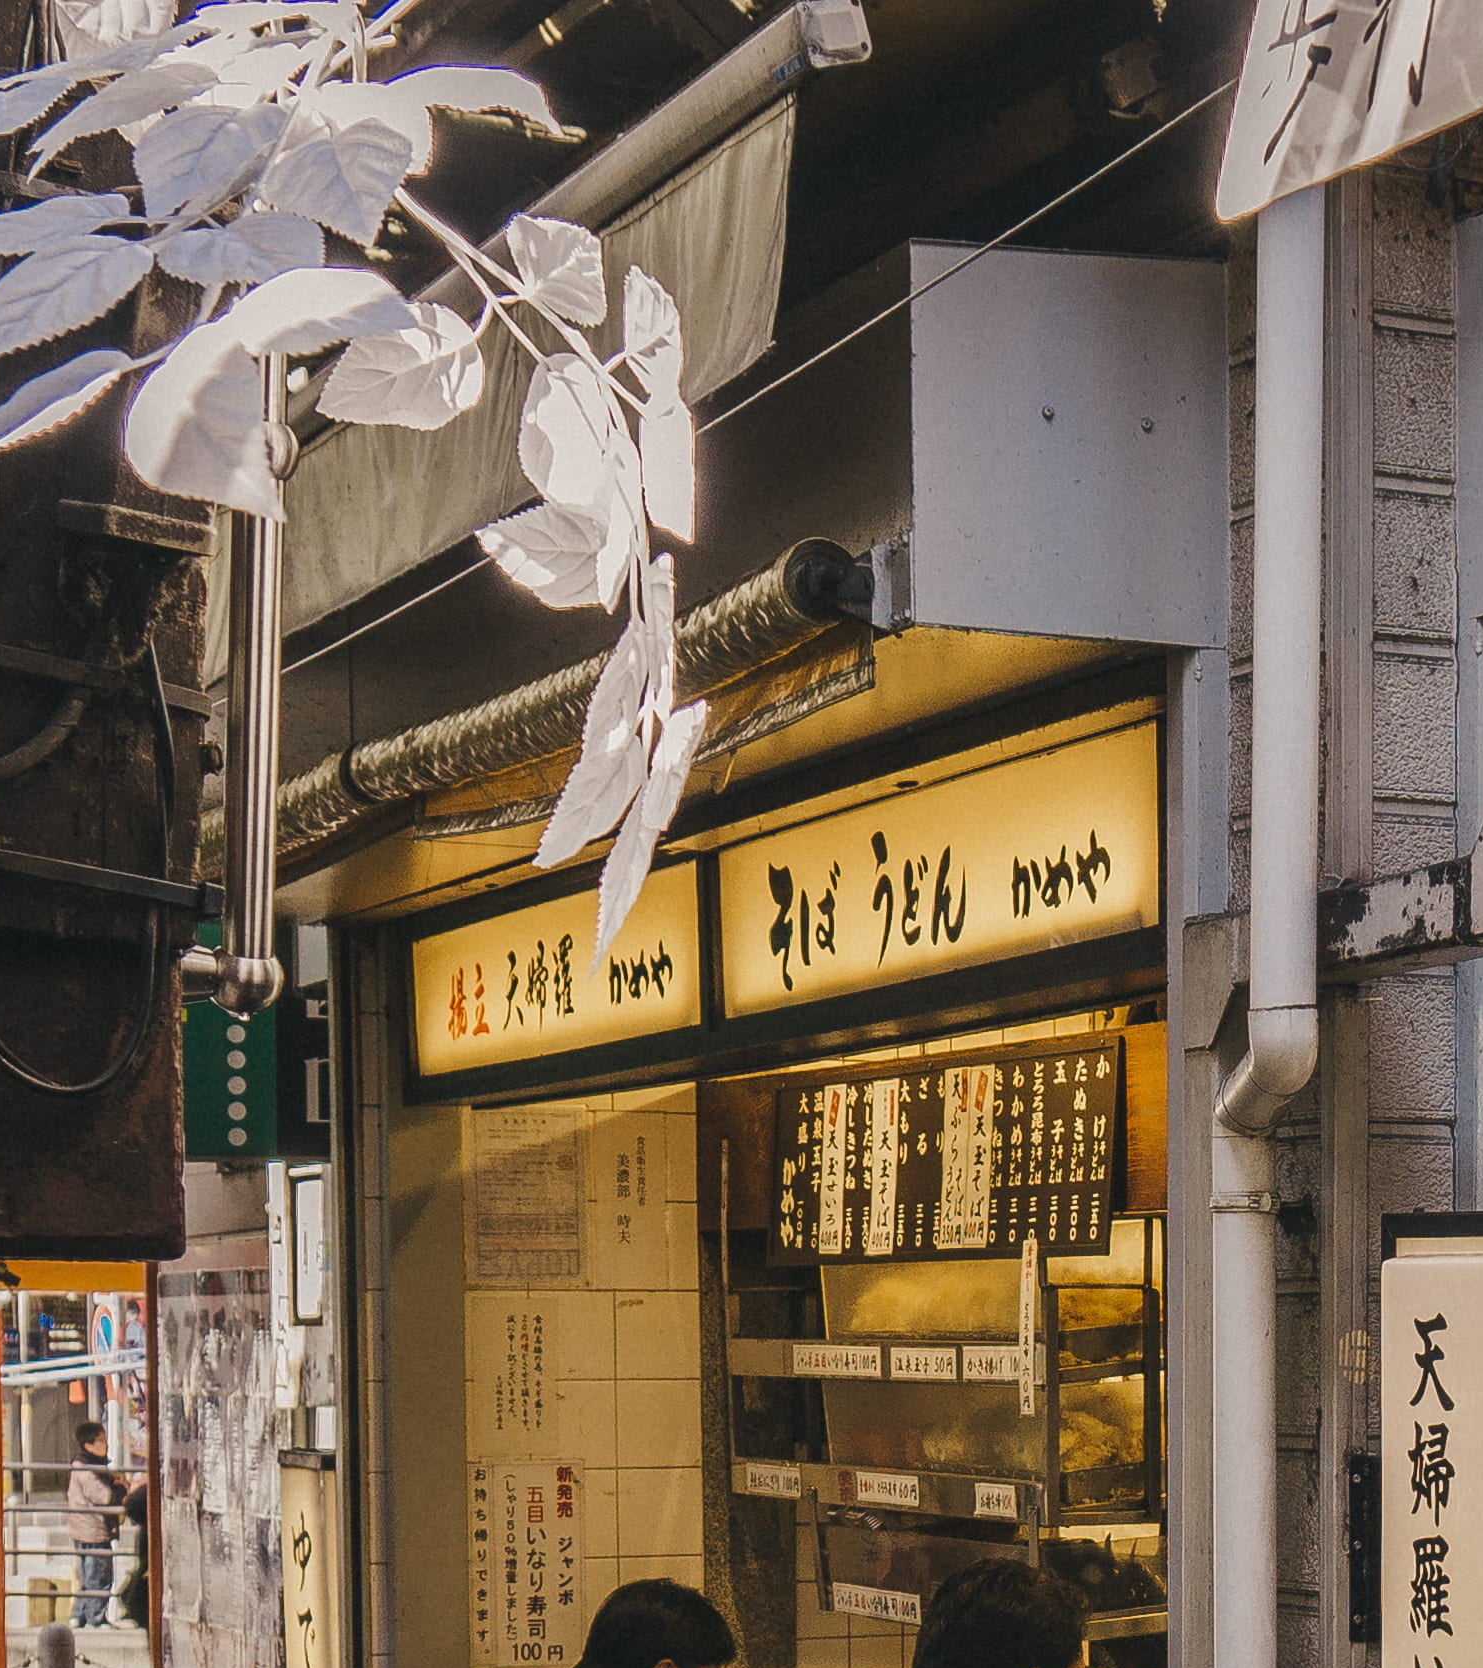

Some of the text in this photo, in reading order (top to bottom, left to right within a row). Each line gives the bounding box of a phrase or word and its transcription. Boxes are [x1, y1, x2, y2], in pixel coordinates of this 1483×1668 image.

[767, 829, 1113, 993] そば うどん かめや
[447, 934, 674, 1042] 揚立 天婦羅 かめや
